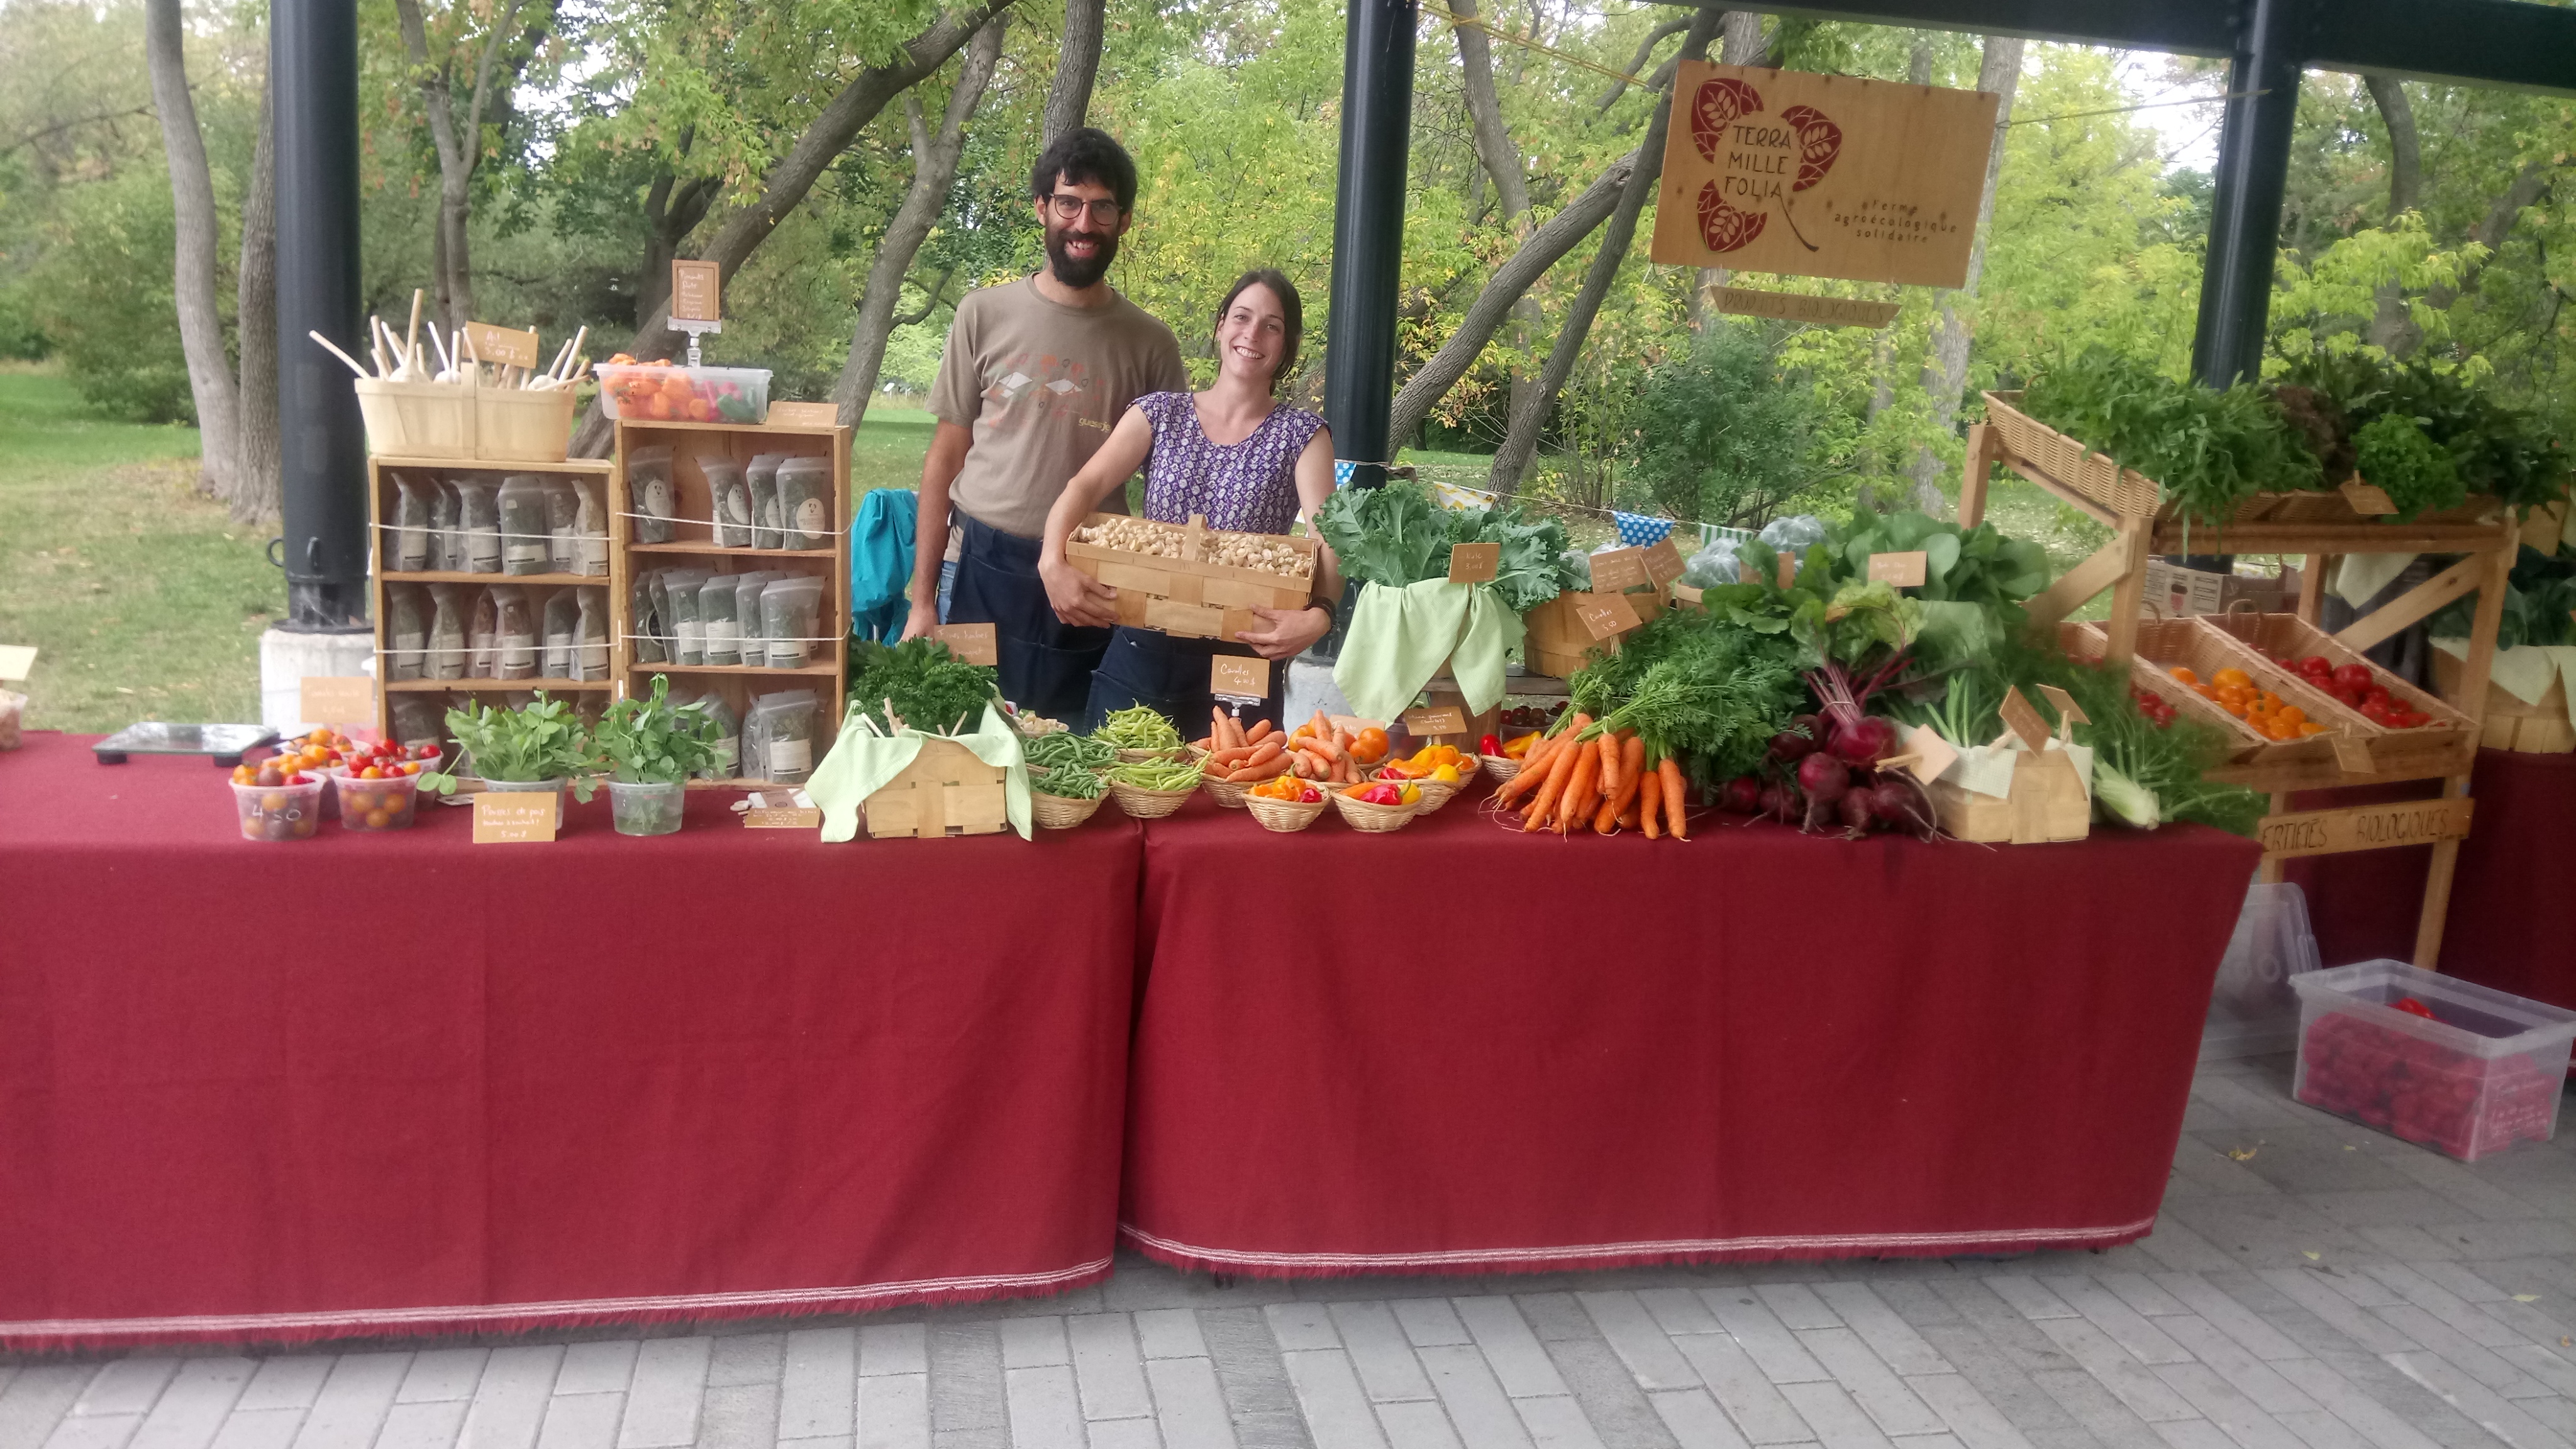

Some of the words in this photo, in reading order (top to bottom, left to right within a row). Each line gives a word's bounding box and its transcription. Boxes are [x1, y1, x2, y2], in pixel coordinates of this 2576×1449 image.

[1733, 125, 1791, 150] TERRA
[1728, 151, 1789, 174] MILLE
[1724, 176, 1782, 199] FOLIA
[1835, 213, 1957, 233] agroécologique
[1856, 228, 1928, 243] solidaire
[1723, 292, 1786, 315] PRODUITS
[1798, 299, 1884, 324] BIOLOGIQUES
[2357, 808, 2450, 843] BIOLOGIQUES
